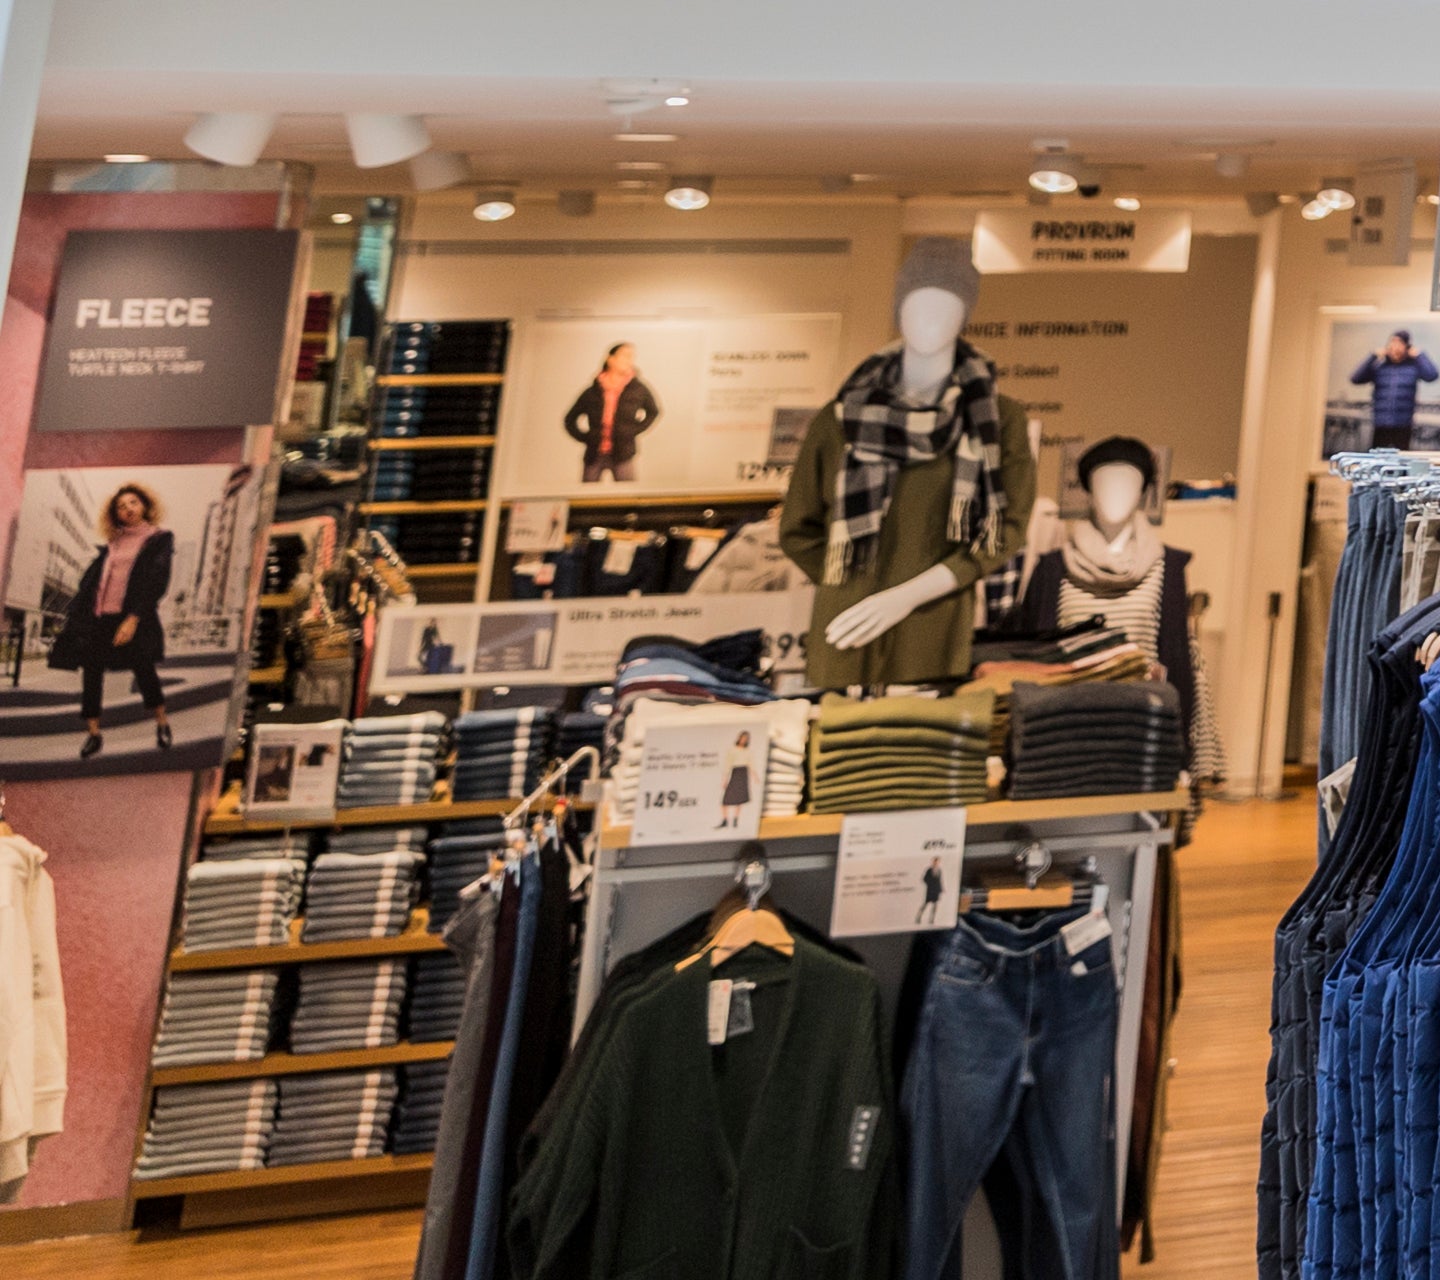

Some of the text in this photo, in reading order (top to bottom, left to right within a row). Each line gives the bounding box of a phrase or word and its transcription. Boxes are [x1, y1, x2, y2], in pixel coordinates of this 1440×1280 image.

[1031, 221, 1135, 240] PROVRUM
[1033, 248, 1129, 260] FITTING ROOM
[76, 298, 213, 329] FLEECE
[645, 791, 678, 809] 149
